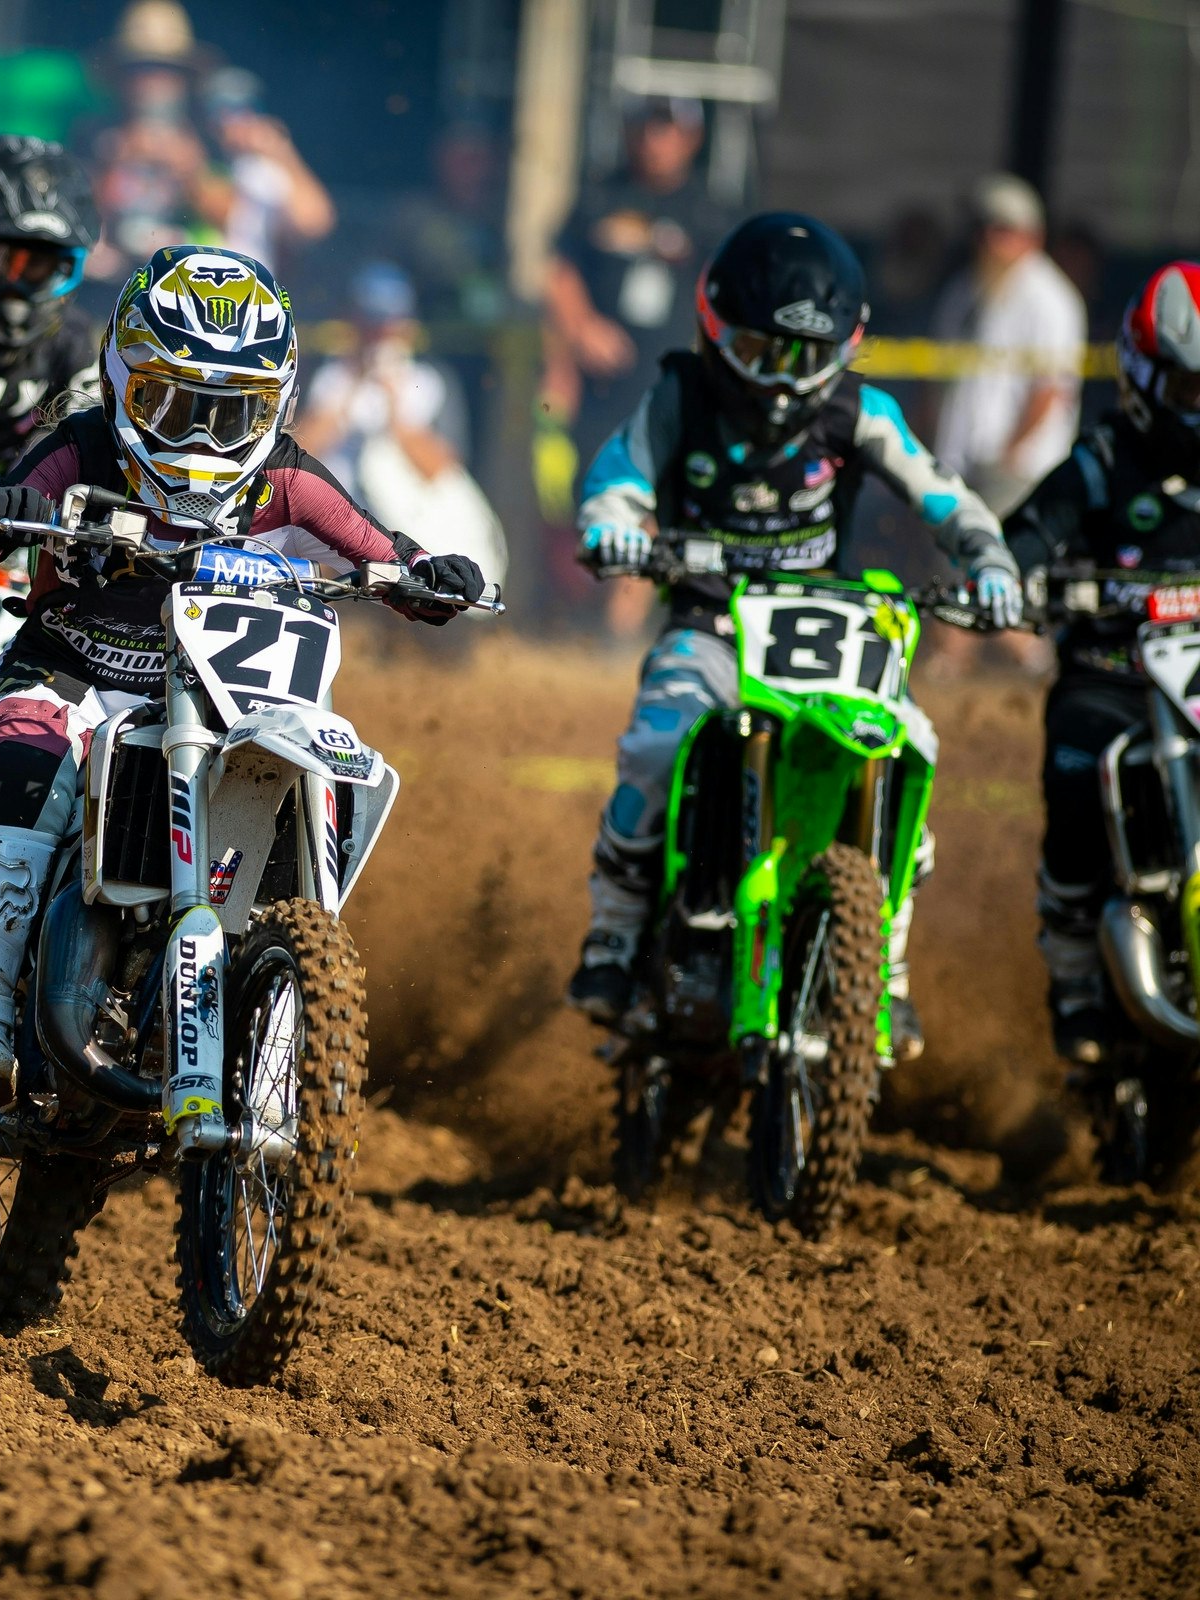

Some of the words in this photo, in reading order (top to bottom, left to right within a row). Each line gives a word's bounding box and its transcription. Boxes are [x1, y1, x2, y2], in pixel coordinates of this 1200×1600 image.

[213, 584, 238, 593] 2021
[92, 630, 150, 650] NATIONAL
[203, 602, 331, 704] 21
[763, 606, 892, 694] 81
[85, 662, 95, 671] AT
[96, 667, 135, 682] LORETTA
[179, 937, 198, 1066] DUNLOP
